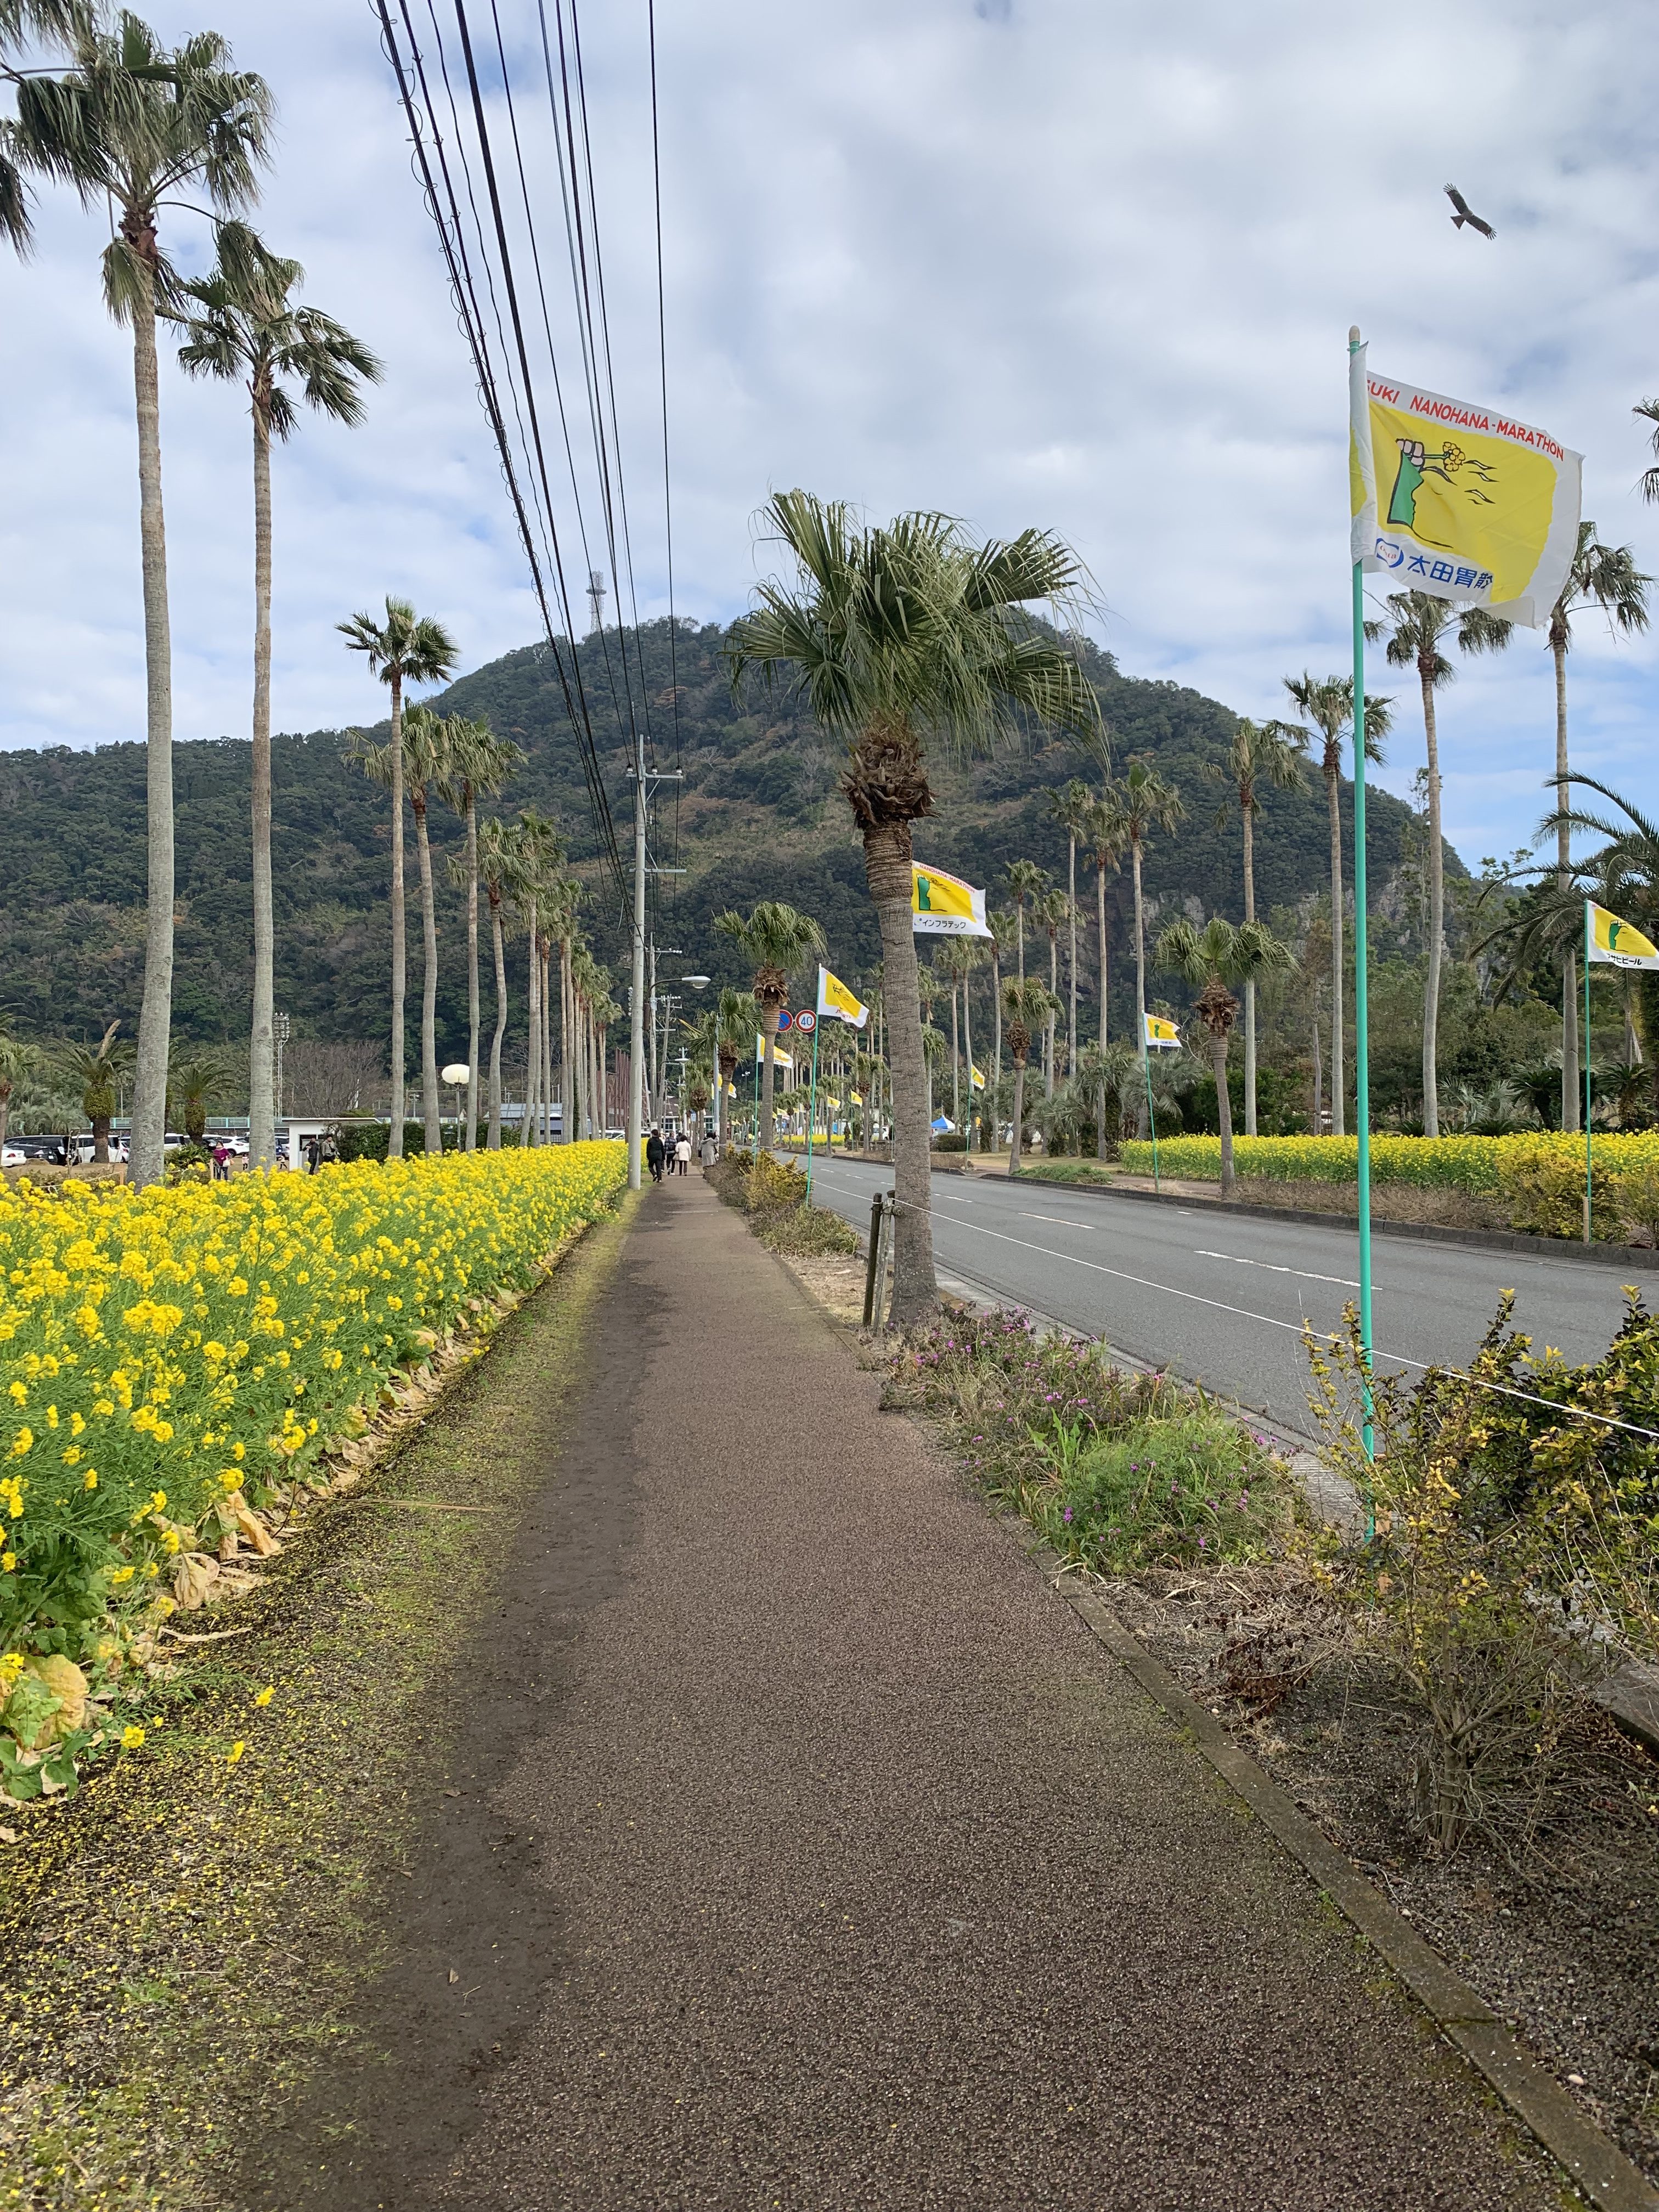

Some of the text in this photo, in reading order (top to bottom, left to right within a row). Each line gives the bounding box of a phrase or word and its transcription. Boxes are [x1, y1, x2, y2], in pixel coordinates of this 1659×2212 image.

[922, 919, 966, 929] インフラテック
[801, 1017, 812, 1025] 40
